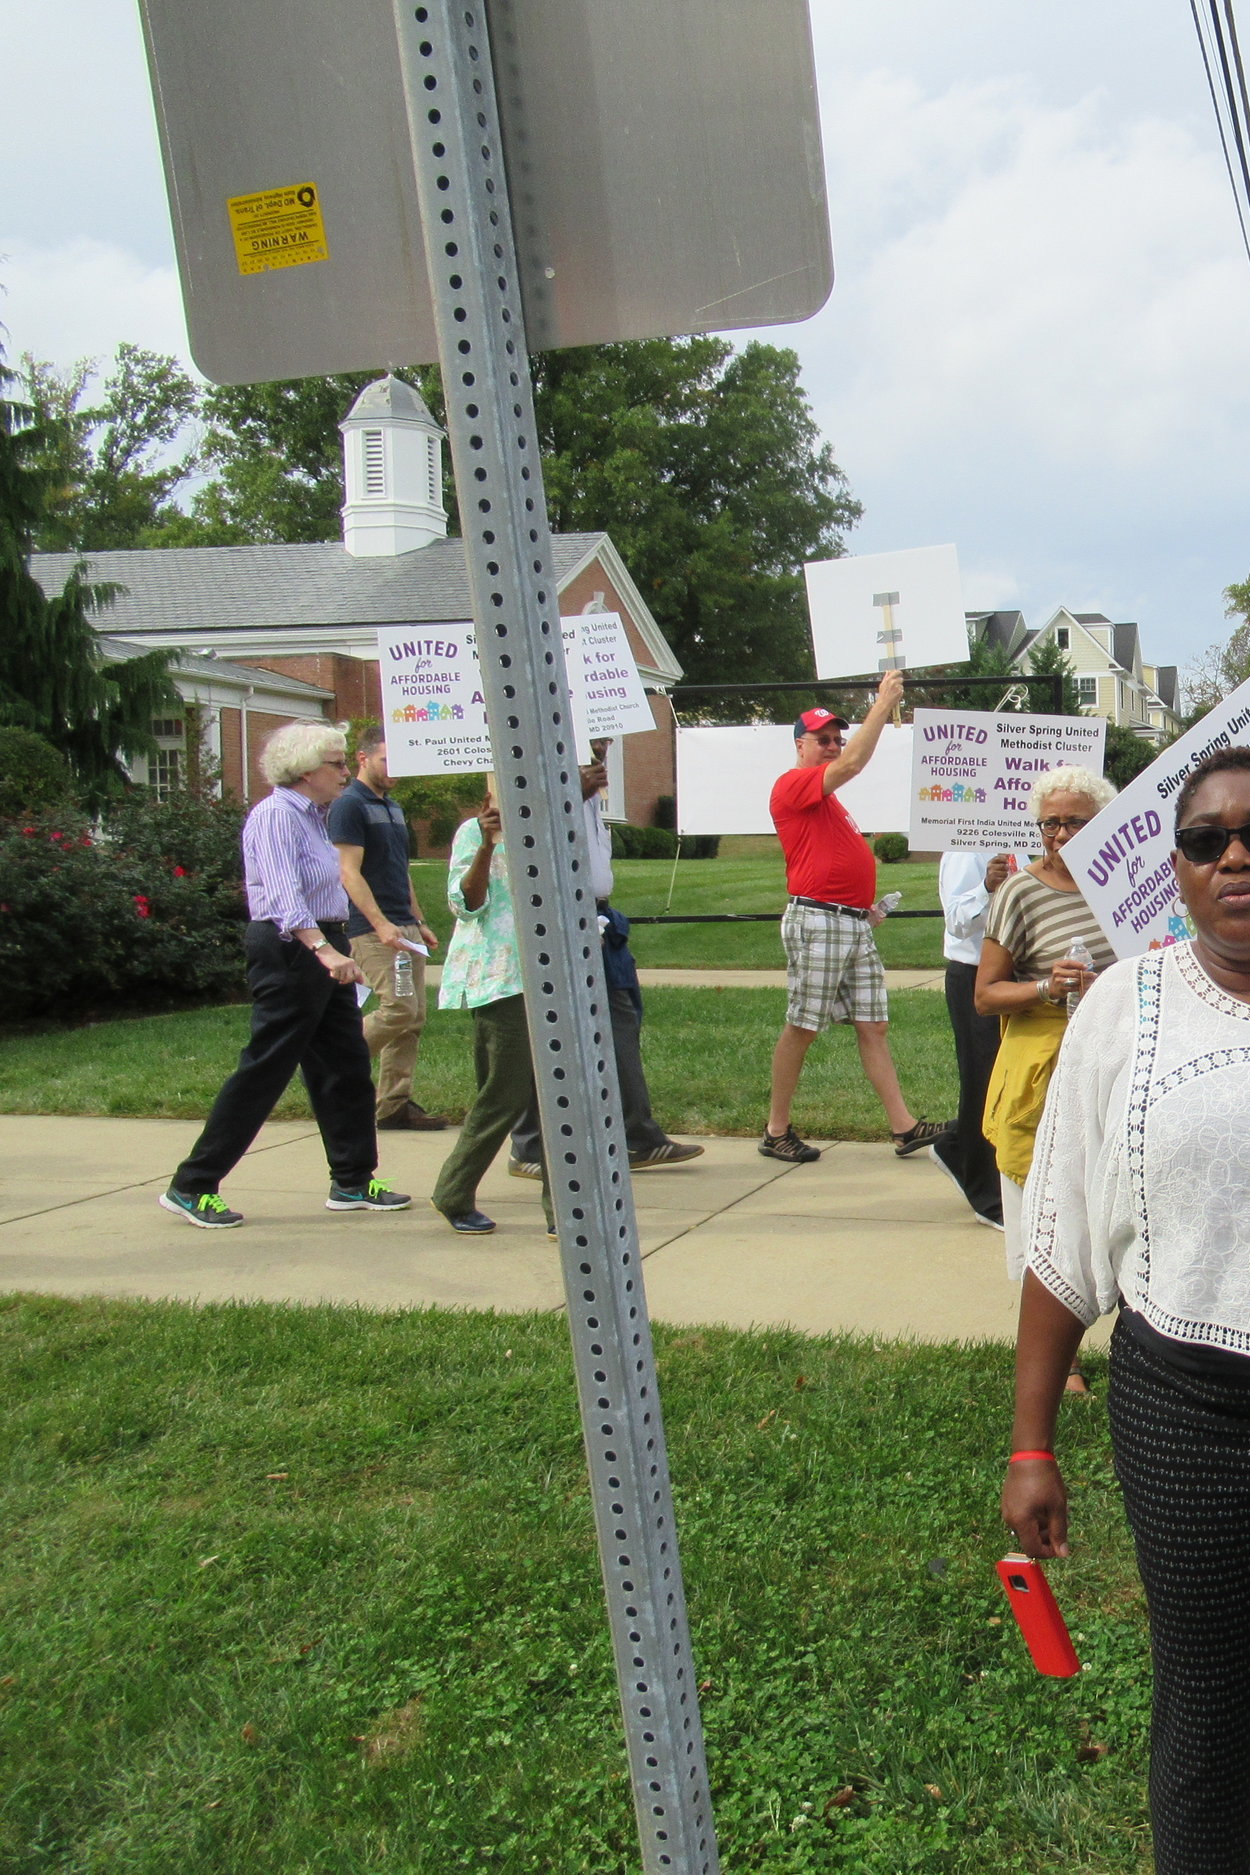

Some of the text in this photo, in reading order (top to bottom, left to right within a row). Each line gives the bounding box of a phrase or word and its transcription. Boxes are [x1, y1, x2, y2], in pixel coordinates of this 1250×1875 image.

[251, 231, 309, 251] WARNING
[591, 621, 618, 632] United
[588, 636, 617, 645] Cluster
[388, 640, 458, 661] UNITED
[595, 651, 616, 663] for
[414, 657, 433, 673] for
[391, 672, 461, 685] AFFORDABLE
[584, 667, 629, 683] rdable
[402, 684, 451, 696] HOUSING
[586, 686, 628, 699] using
[589, 704, 618, 714] Methodist
[619, 702, 640, 711] Church
[597, 715, 615, 723] Road
[601, 722, 624, 731] 20910
[996, 722, 1099, 738] Silver Spring United
[923, 724, 988, 744] UNITED
[408, 739, 422, 747] St.
[425, 737, 446, 746] Paul
[449, 736, 481, 744] United
[1000, 738, 1093, 752] Methodist Cluster
[437, 746, 492, 756] 2601 Colos
[945, 740, 963, 756] for
[443, 759, 474, 767] Chevy
[921, 755, 988, 767] AFFORDABLE
[1004, 757, 1050, 772] Walk
[1157, 763, 1191, 799] Silver
[1190, 730, 1231, 767] Spring
[931, 766, 977, 777] HOUSING
[921, 817, 956, 825] Memorial
[958, 818, 975, 826] First
[976, 818, 996, 826] India
[998, 819, 1022, 827] United
[957, 828, 980, 836] 9226
[982, 829, 1026, 838] Colesville
[979, 840, 1011, 849] Spring,
[1014, 840, 1028, 848] MD
[1087, 810, 1162, 887] UNITED
[1126, 855, 1146, 888] for
[1111, 857, 1175, 928] AFFORDABL
